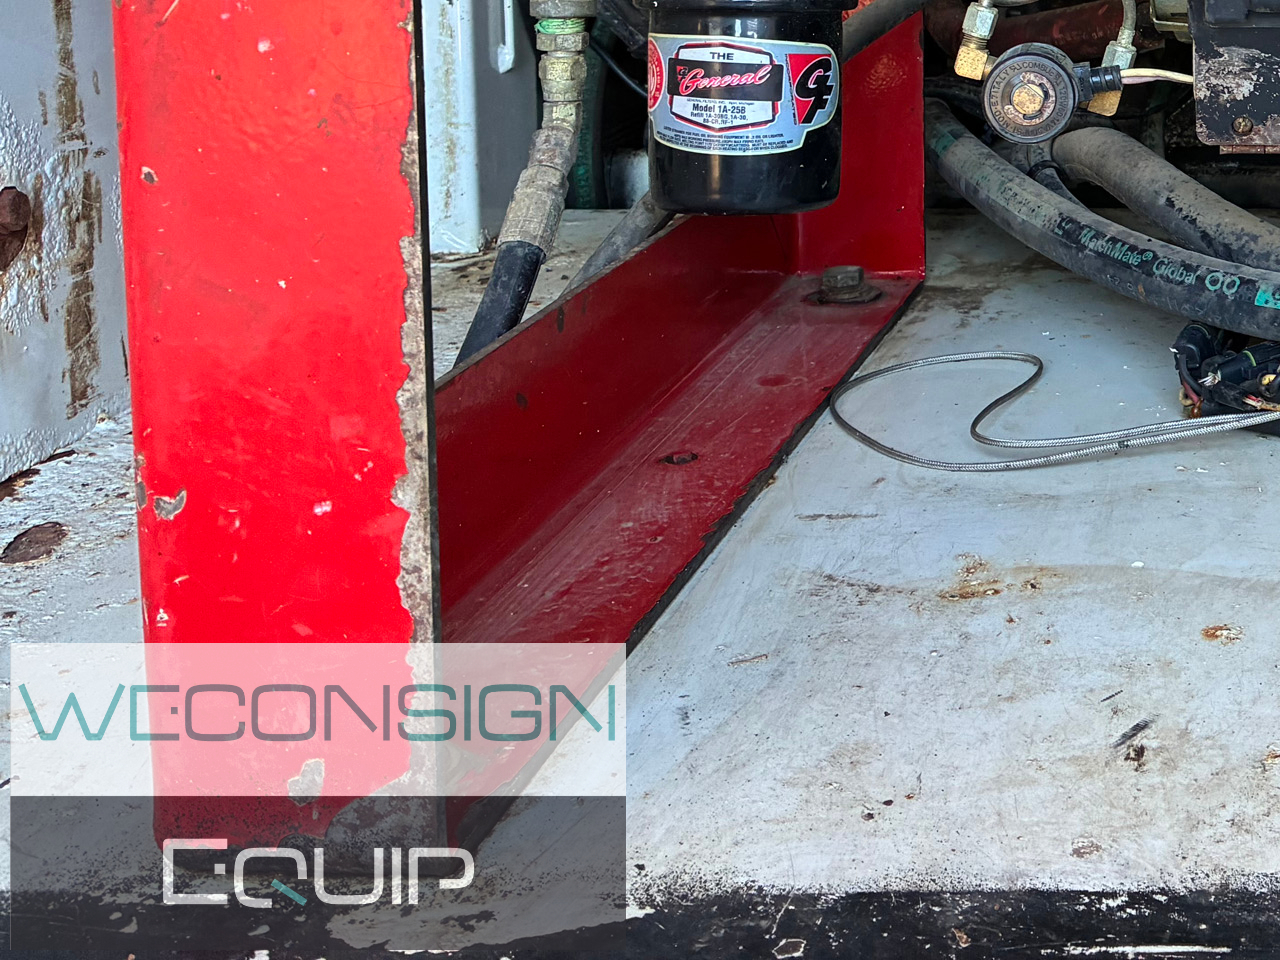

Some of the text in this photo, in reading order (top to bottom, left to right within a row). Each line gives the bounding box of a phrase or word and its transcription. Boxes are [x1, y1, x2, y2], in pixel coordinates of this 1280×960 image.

[709, 52, 735, 61] THE
[680, 64, 773, 96] General
[692, 103, 715, 112] Model
[1152, 258, 1201, 286] Global
